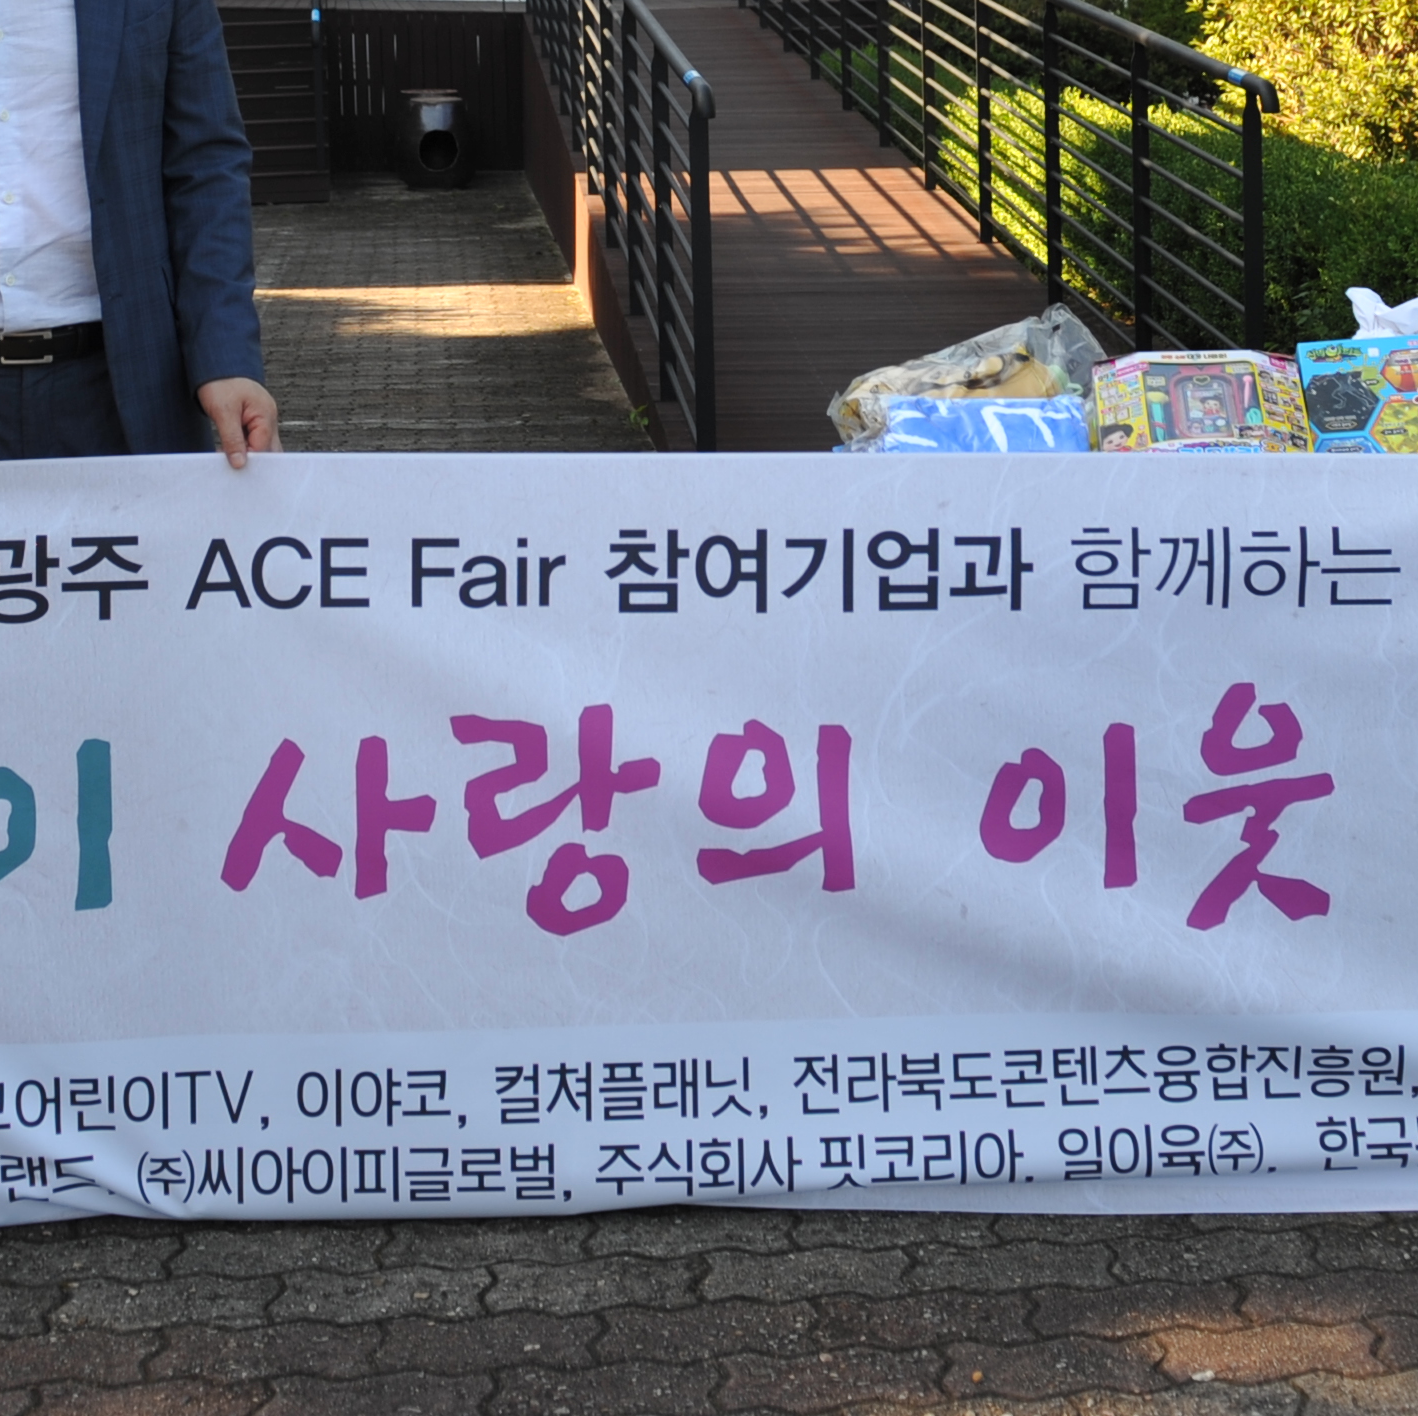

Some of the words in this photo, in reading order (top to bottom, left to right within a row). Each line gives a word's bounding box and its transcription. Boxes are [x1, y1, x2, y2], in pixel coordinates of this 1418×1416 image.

[186, 537, 369, 609] ACE
[412, 538, 565, 608] Fair
[606, 528, 1033, 613] 참여기업과
[1072, 527, 1400, 609] 함께하는
[222, 704, 854, 935] 사랑의
[981, 683, 1334, 930] 이웃
[298, 1069, 466, 1128] 이야코,
[496, 1057, 767, 1123] 컬쳐플래닛,
[794, 1044, 1418, 1114] 전라북도콘텐츠융합진흥원,
[596, 1137, 802, 1196] 주식회사
